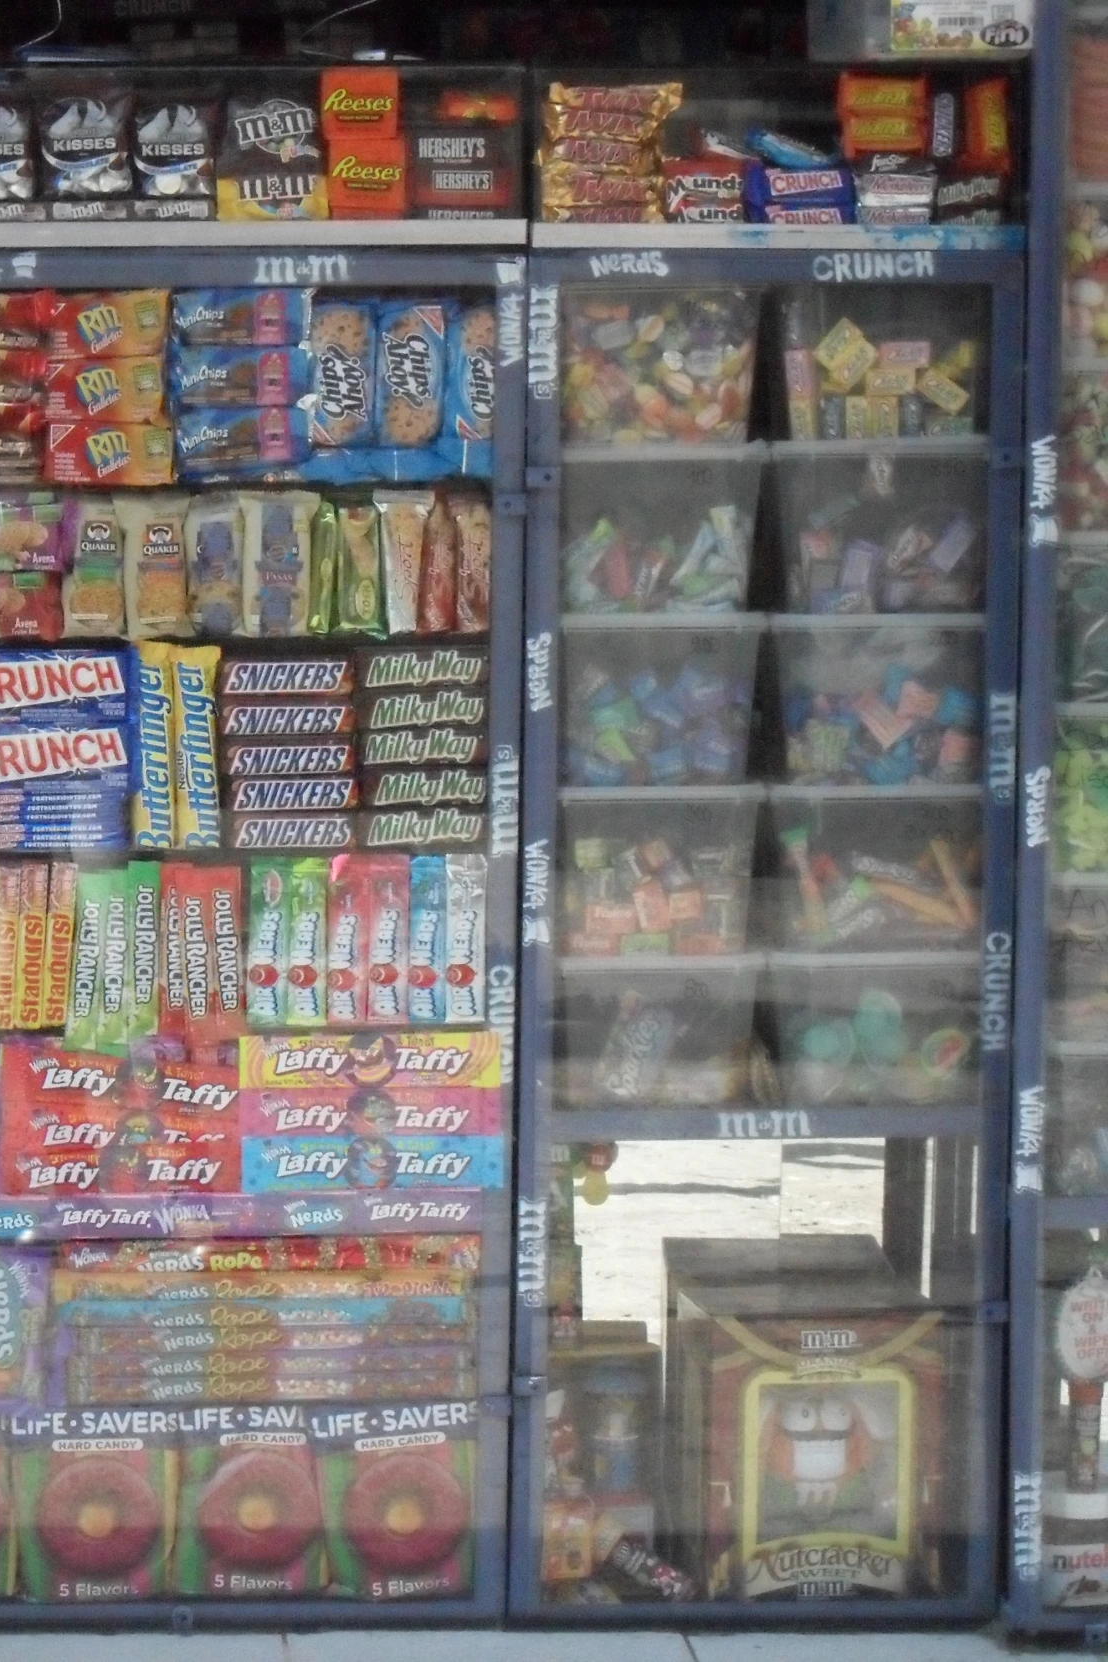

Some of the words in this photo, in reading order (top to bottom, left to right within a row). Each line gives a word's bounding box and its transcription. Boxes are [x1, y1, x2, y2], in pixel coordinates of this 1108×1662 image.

[324, 89, 393, 112] Reese's
[53, 138, 117, 151] KISSES
[142, 143, 205, 156] KISSES
[418, 138, 485, 158] HERSHEY'S
[333, 156, 402, 181] Reese's
[435, 173, 490, 189] HERSHEY'S
[770, 171, 842, 194] CRUNCH
[814, 252, 934, 282] CRUNCH
[90, 330, 124, 353] Galletas
[498, 292, 525, 367] WONKA
[320, 353, 346, 420] Chips
[88, 392, 122, 416] Galletas
[97, 455, 131, 478] Galletas
[1030, 434, 1058, 509] WONKA
[32, 553, 55, 564] Avena
[81, 541, 117, 553] QUAKER
[143, 543, 180, 555] QUAKER
[16, 618, 38, 628] Avena
[226, 662, 343, 693] SNICKERS
[226, 706, 343, 733] SNICKERS
[136, 664, 173, 848] Butterfinger
[185, 661, 220, 849] Butterfinger
[231, 746, 348, 775] SNICKERS
[235, 780, 352, 811] SNICKERS
[237, 818, 350, 847] SNICKERS
[135, 884, 154, 931] JOLLY
[185, 897, 207, 942] JOLLY
[214, 890, 232, 934] JOLLY
[78, 899, 101, 947] JOLLY
[259, 910, 283, 963] HEADS
[296, 911, 320, 964] HEADS
[335, 914, 360, 968] HEADS
[75, 945, 100, 1018] RANCHER
[134, 930, 157, 1005] RANCHER
[186, 941, 208, 1019] RANCHER
[214, 933, 238, 1012] RANCHER
[984, 932, 1012, 1050] CRUNCH
[274, 1048, 348, 1075] Laffy
[395, 1048, 473, 1075] Taffy
[42, 1068, 116, 1097] Laffy
[163, 1078, 238, 1111] Taffy
[276, 1105, 347, 1133] Laffy
[395, 1105, 469, 1132] Taffy
[1016, 1086, 1045, 1156] WONKA
[277, 1151, 348, 1178] Laffy
[395, 1152, 471, 1179] Taffy
[312, 1414, 369, 1438] LIFE
[748, 1546, 892, 1582] Nutcracker
